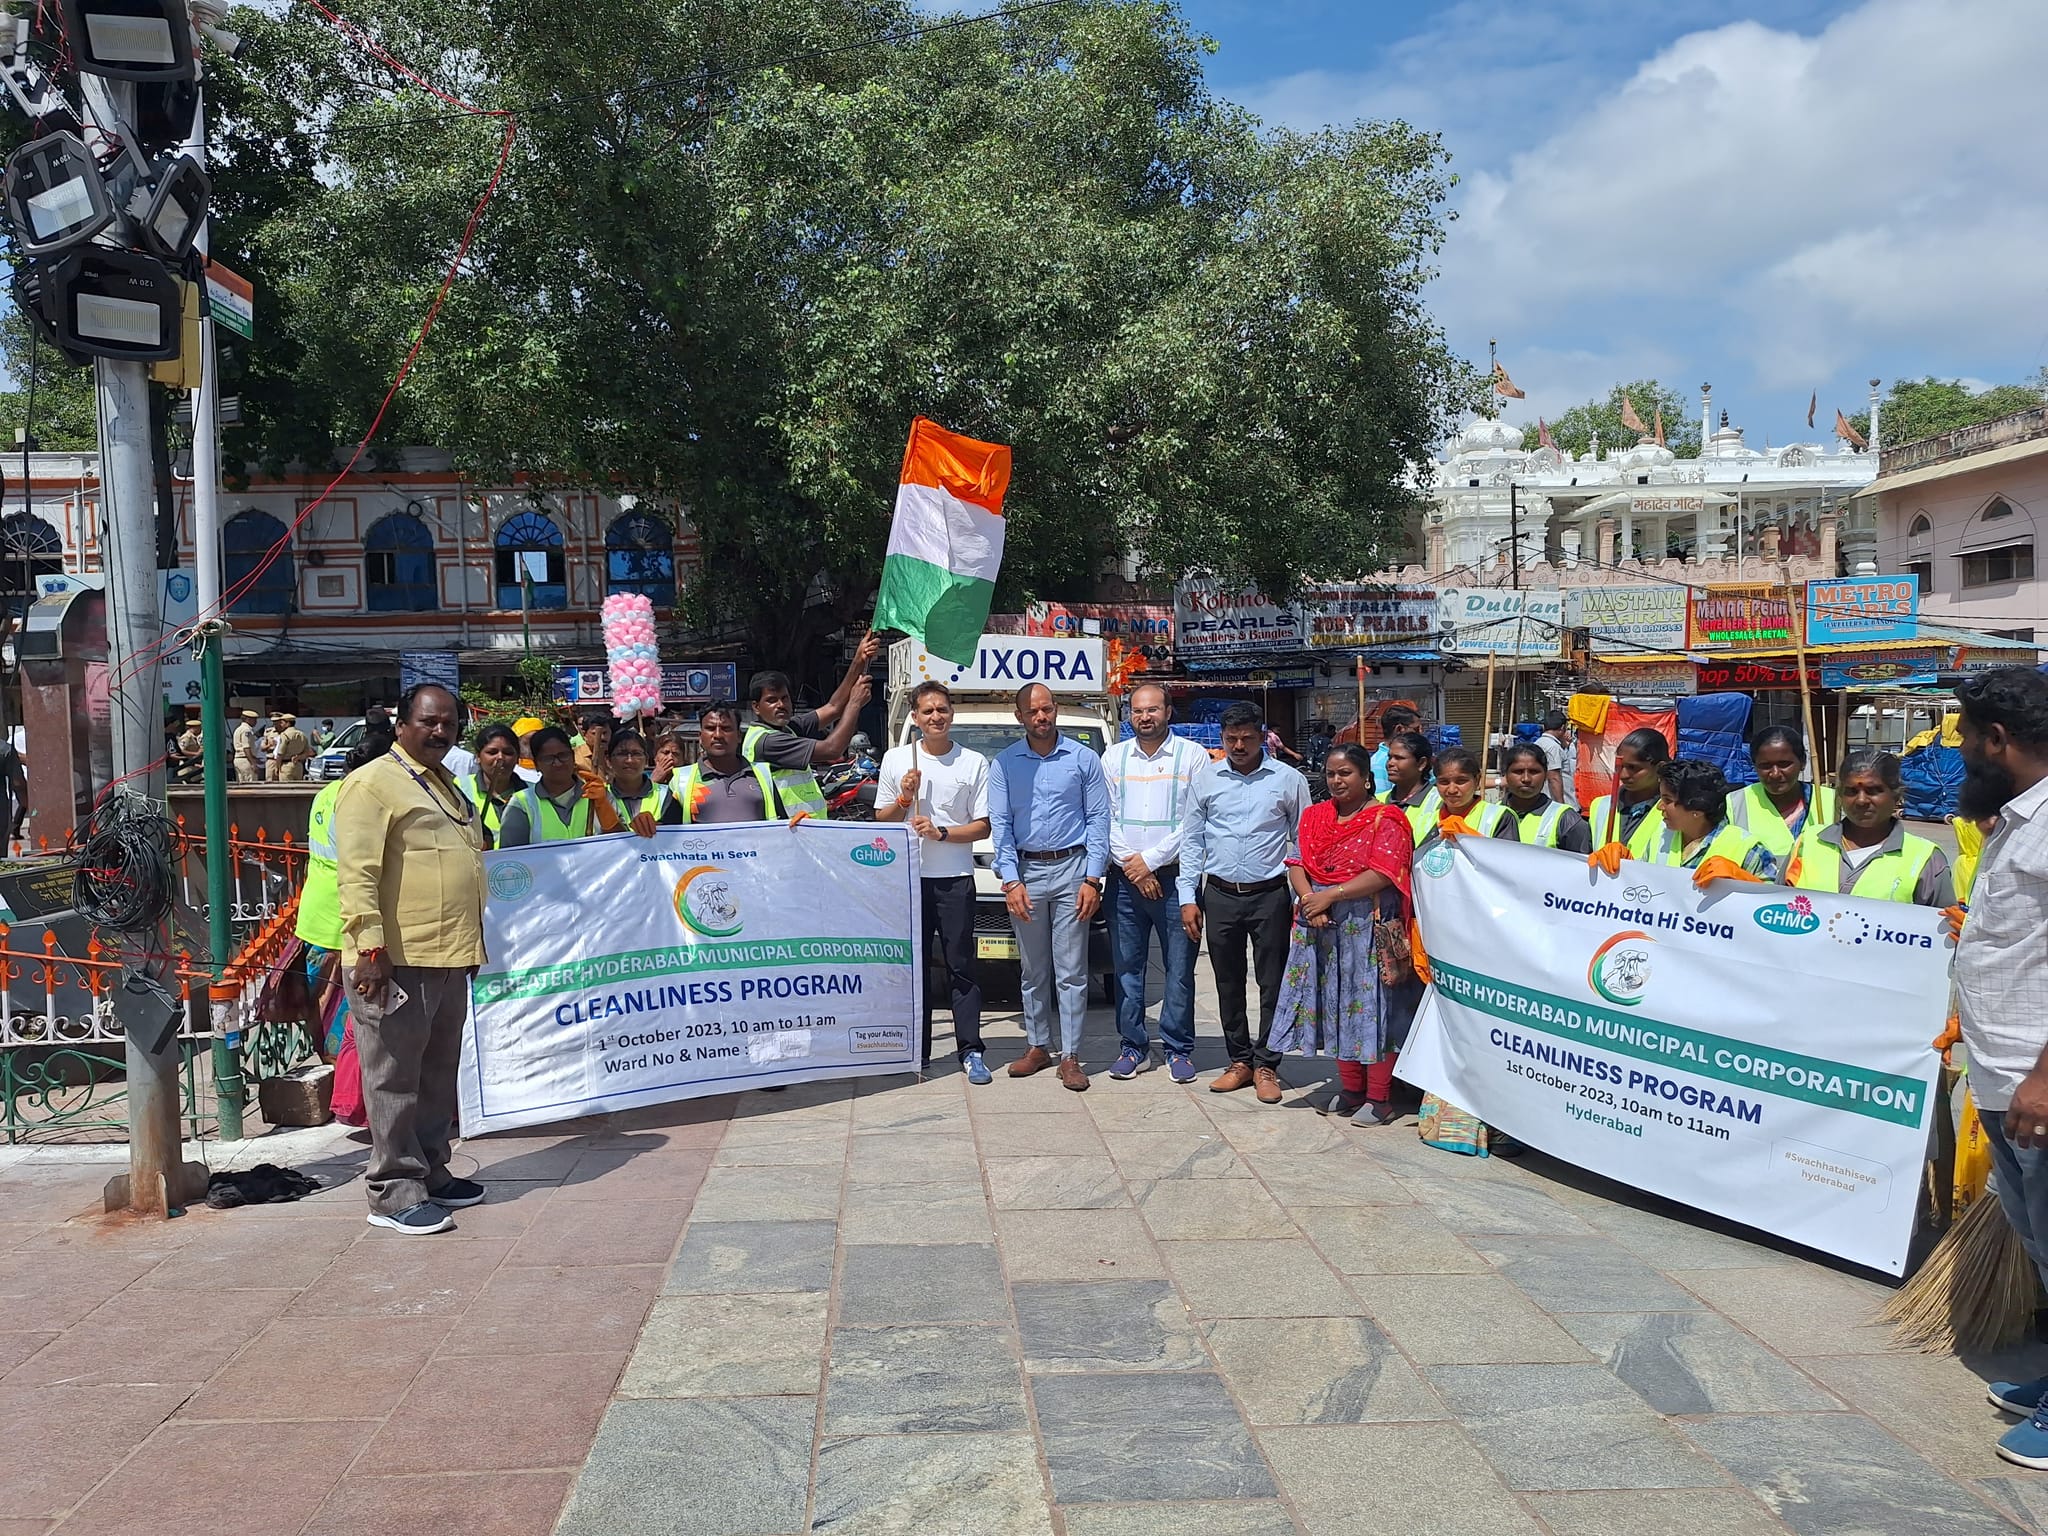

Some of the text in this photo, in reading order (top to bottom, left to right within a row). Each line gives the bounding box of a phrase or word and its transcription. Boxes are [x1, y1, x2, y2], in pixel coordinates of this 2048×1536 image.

[52, 152, 71, 168] 120 W
[128, 278, 154, 288] 120 W
[1633, 496, 1703, 511] महादेव मंदिर
[1581, 591, 1687, 612] MASTANA
[1815, 582, 1913, 604] METRO
[1466, 595, 1560, 614] Dulhan
[1815, 601, 1912, 621] PEARLS
[1182, 615, 1298, 633] PEARLS
[1363, 616, 1429, 632] PEARLS
[1582, 610, 1685, 626] PEARLS
[1700, 617, 1749, 630] JEWELLERS
[1239, 630, 1248, 641] &
[1249, 628, 1294, 641] Bangles
[1633, 624, 1641, 633] &
[1642, 623, 1683, 632] BANGLES
[1709, 630, 1754, 641] WHOLESALE
[1762, 629, 1788, 639] RETAIL
[1460, 640, 1508, 650] JEWELLERS
[1521, 641, 1560, 651] BANGLES
[161, 656, 183, 666] LICE
[980, 648, 1094, 681] IXORA
[1827, 653, 1875, 663] METRO
[1880, 651, 1933, 661] PEARLS
[1734, 665, 1776, 682] 50%
[640, 849, 758, 863] Swachhata Hi Seva
[855, 848, 893, 862] GHMC
[1543, 892, 1735, 940] Swachhata Hi Seva
[1760, 906, 1815, 932] GHMC
[1875, 924, 1933, 949] ixora
[487, 942, 905, 997] GREATER HYDERABAD MUNICIPAL CORPORATION
[555, 974, 863, 1026] CLEANLINESS PROGRAM
[617, 1029, 681, 1049] October
[685, 1022, 727, 1038] 2023,
[730, 1020, 749, 1034] 10
[752, 1020, 775, 1032] am
[778, 1017, 793, 1030] to
[796, 1015, 811, 1028] 11
[815, 1015, 836, 1026] am
[855, 1030, 904, 1041] Tag your Activity
[1474, 983, 1583, 1030] HYDERABAD
[1585, 1015, 1710, 1065] MUNICIPAL
[1714, 1049, 1916, 1113] CORPORATION
[604, 1054, 648, 1074] Ward
[652, 1052, 674, 1067] No
[678, 1049, 692, 1062] &
[696, 1045, 741, 1060] Name
[1490, 1028, 1763, 1125] CLEANLINESS PROGRAM
[1506, 1060, 1731, 1141] 1st October 2023, 10am to 11am
[1565, 1101, 1643, 1138] Hyderabad
[1784, 1151, 1877, 1185] #Swachhatahiseva
[1801, 1168, 1856, 1192] hyderabad
